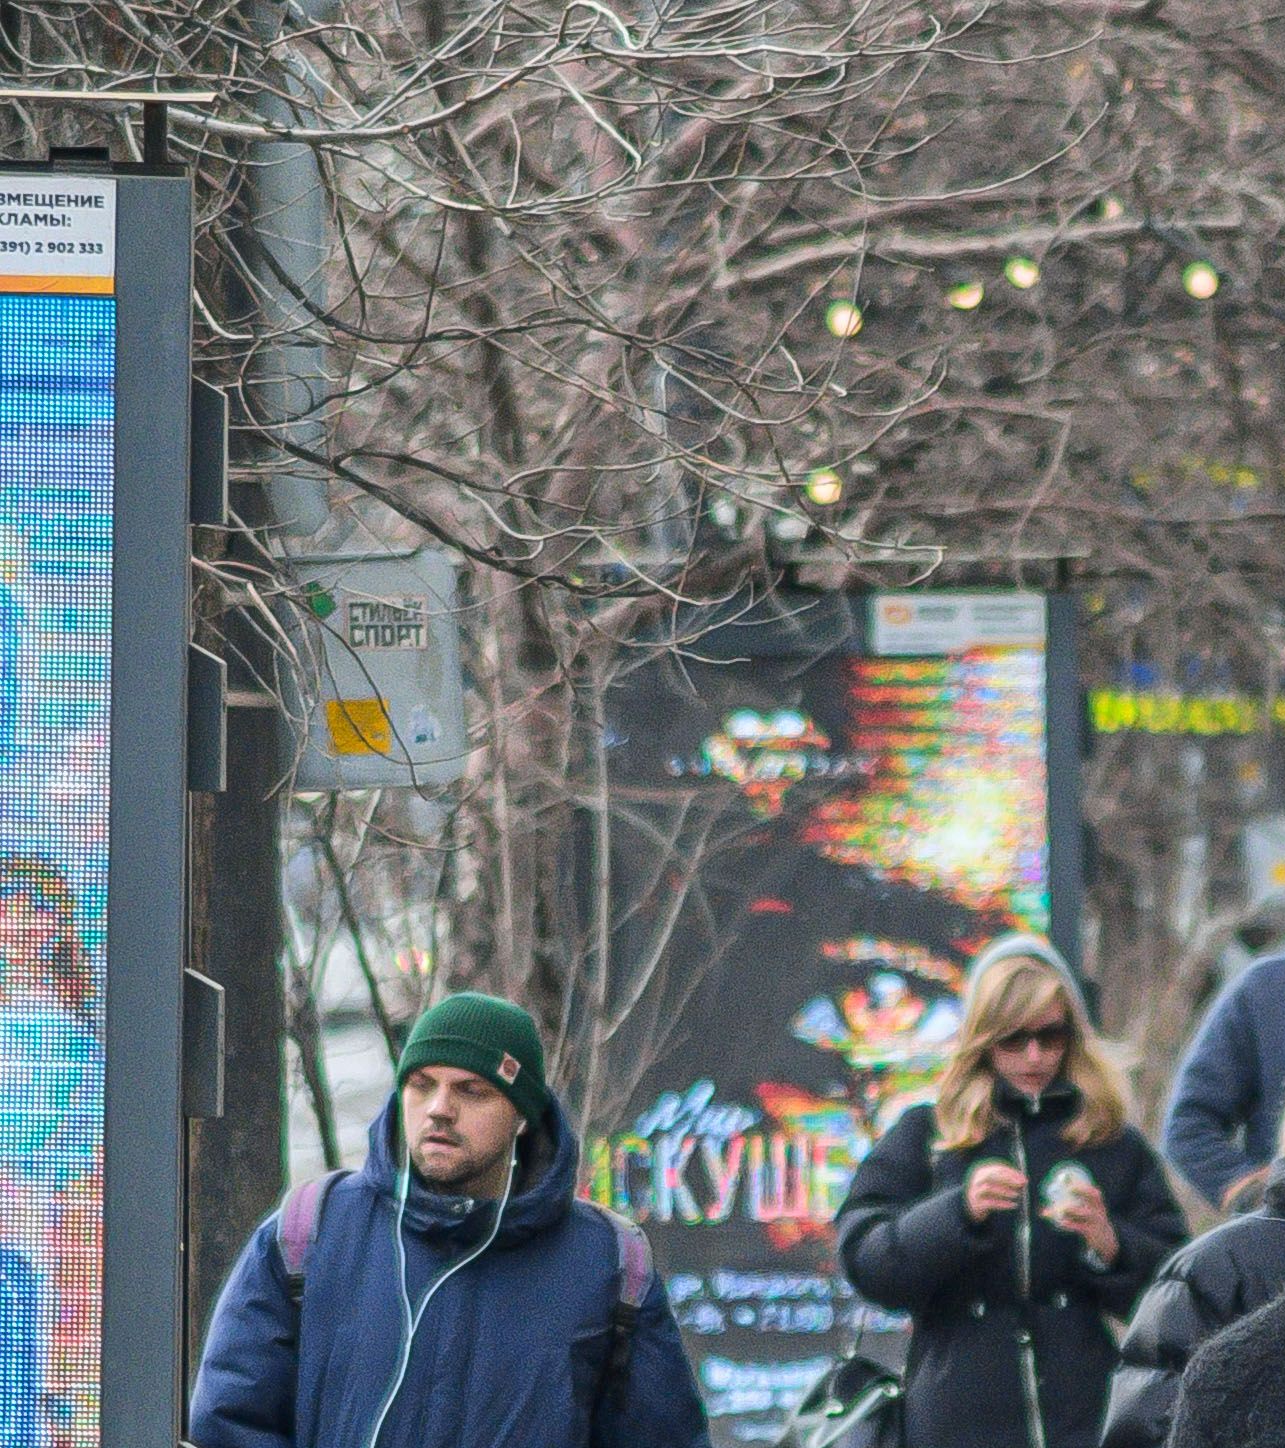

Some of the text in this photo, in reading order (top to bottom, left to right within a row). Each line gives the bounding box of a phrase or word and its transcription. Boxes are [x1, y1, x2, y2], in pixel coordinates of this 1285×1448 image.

[35, 242, 43, 253] 2
[47, 242, 75, 254] 902
[79, 243, 103, 254] 333
[350, 624, 424, 647] СПОРТ
